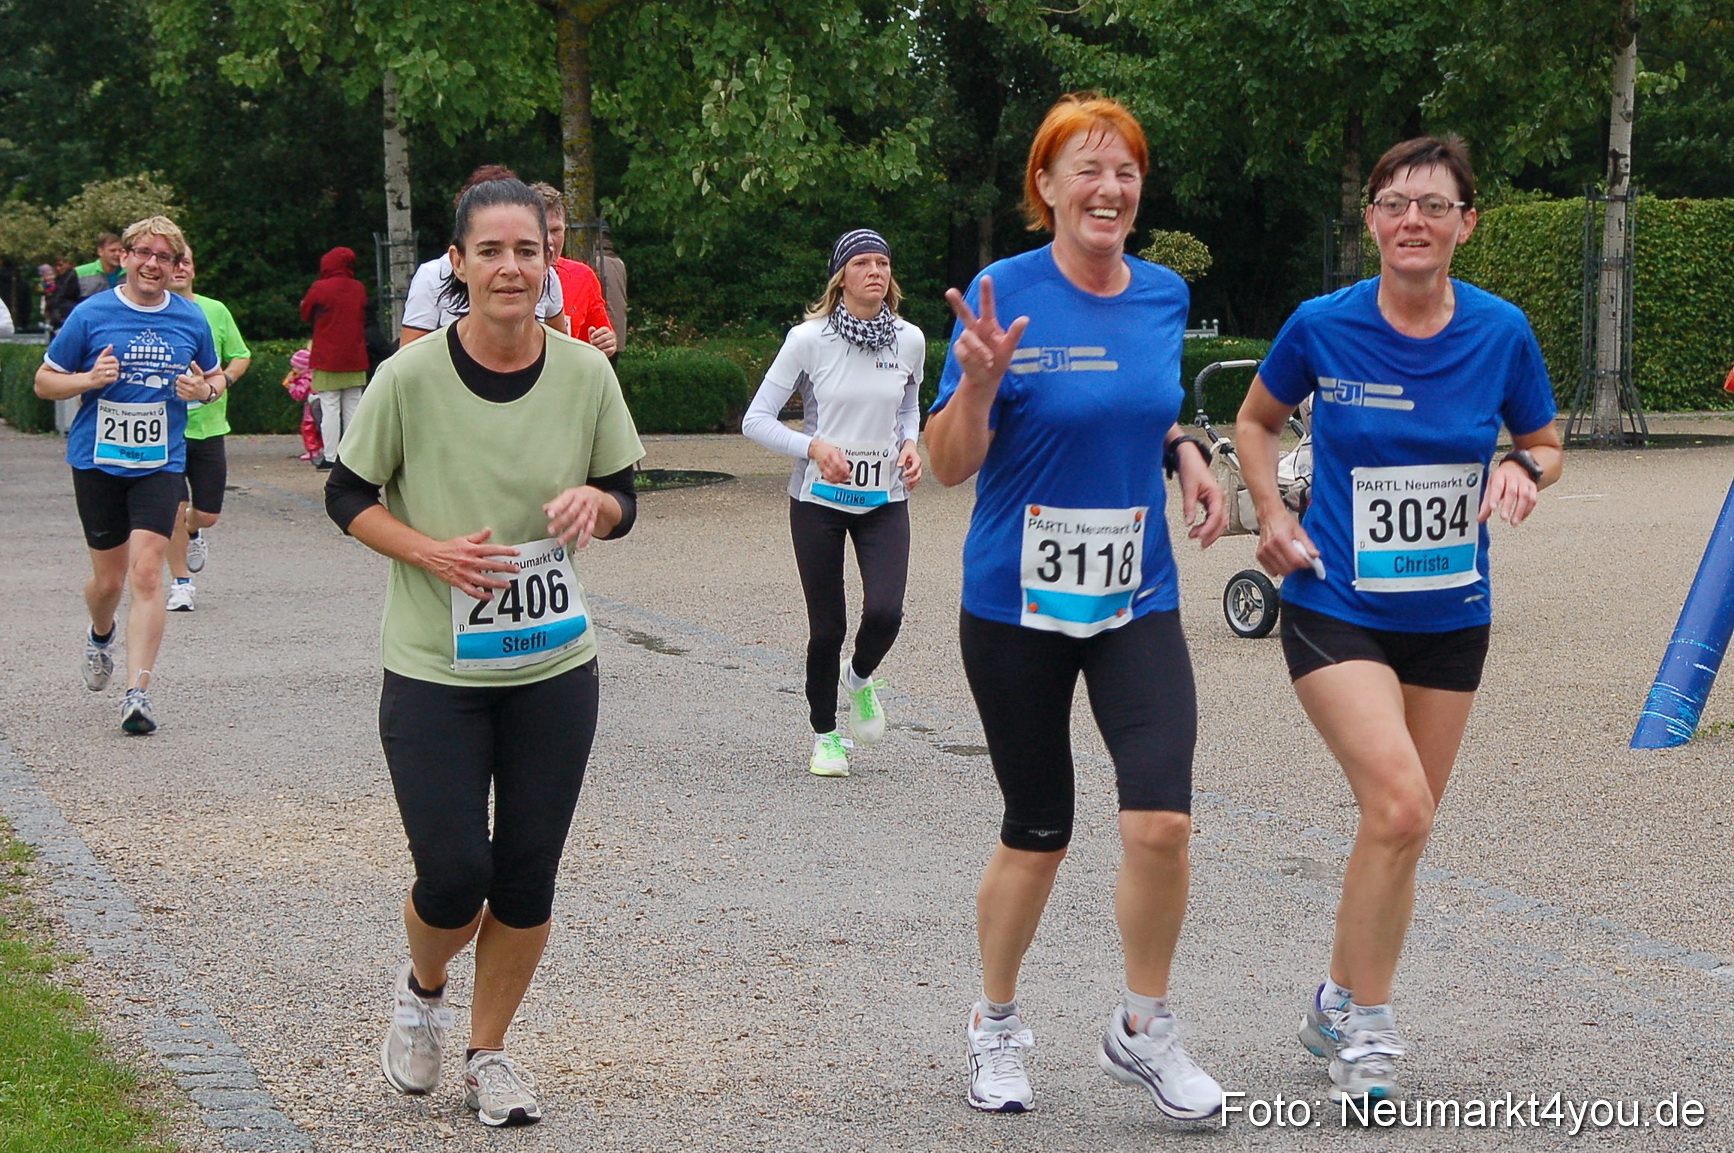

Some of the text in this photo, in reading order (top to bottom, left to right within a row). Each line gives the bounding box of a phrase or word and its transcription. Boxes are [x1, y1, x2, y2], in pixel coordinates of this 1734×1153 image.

[104, 417, 161, 444] 2169
[120, 449, 144, 460] Peter
[845, 448, 880, 457] Neumarkt
[1356, 477, 1463, 492] PARTL Neumarkt
[834, 490, 866, 505] Ulrike
[1028, 518, 1072, 534] PARTL
[1369, 494, 1469, 544] 3034
[1036, 539, 1134, 588] 3118
[1394, 555, 1450, 574] Christa
[468, 568, 569, 626] 2406
[502, 631, 547, 653] Steffi
